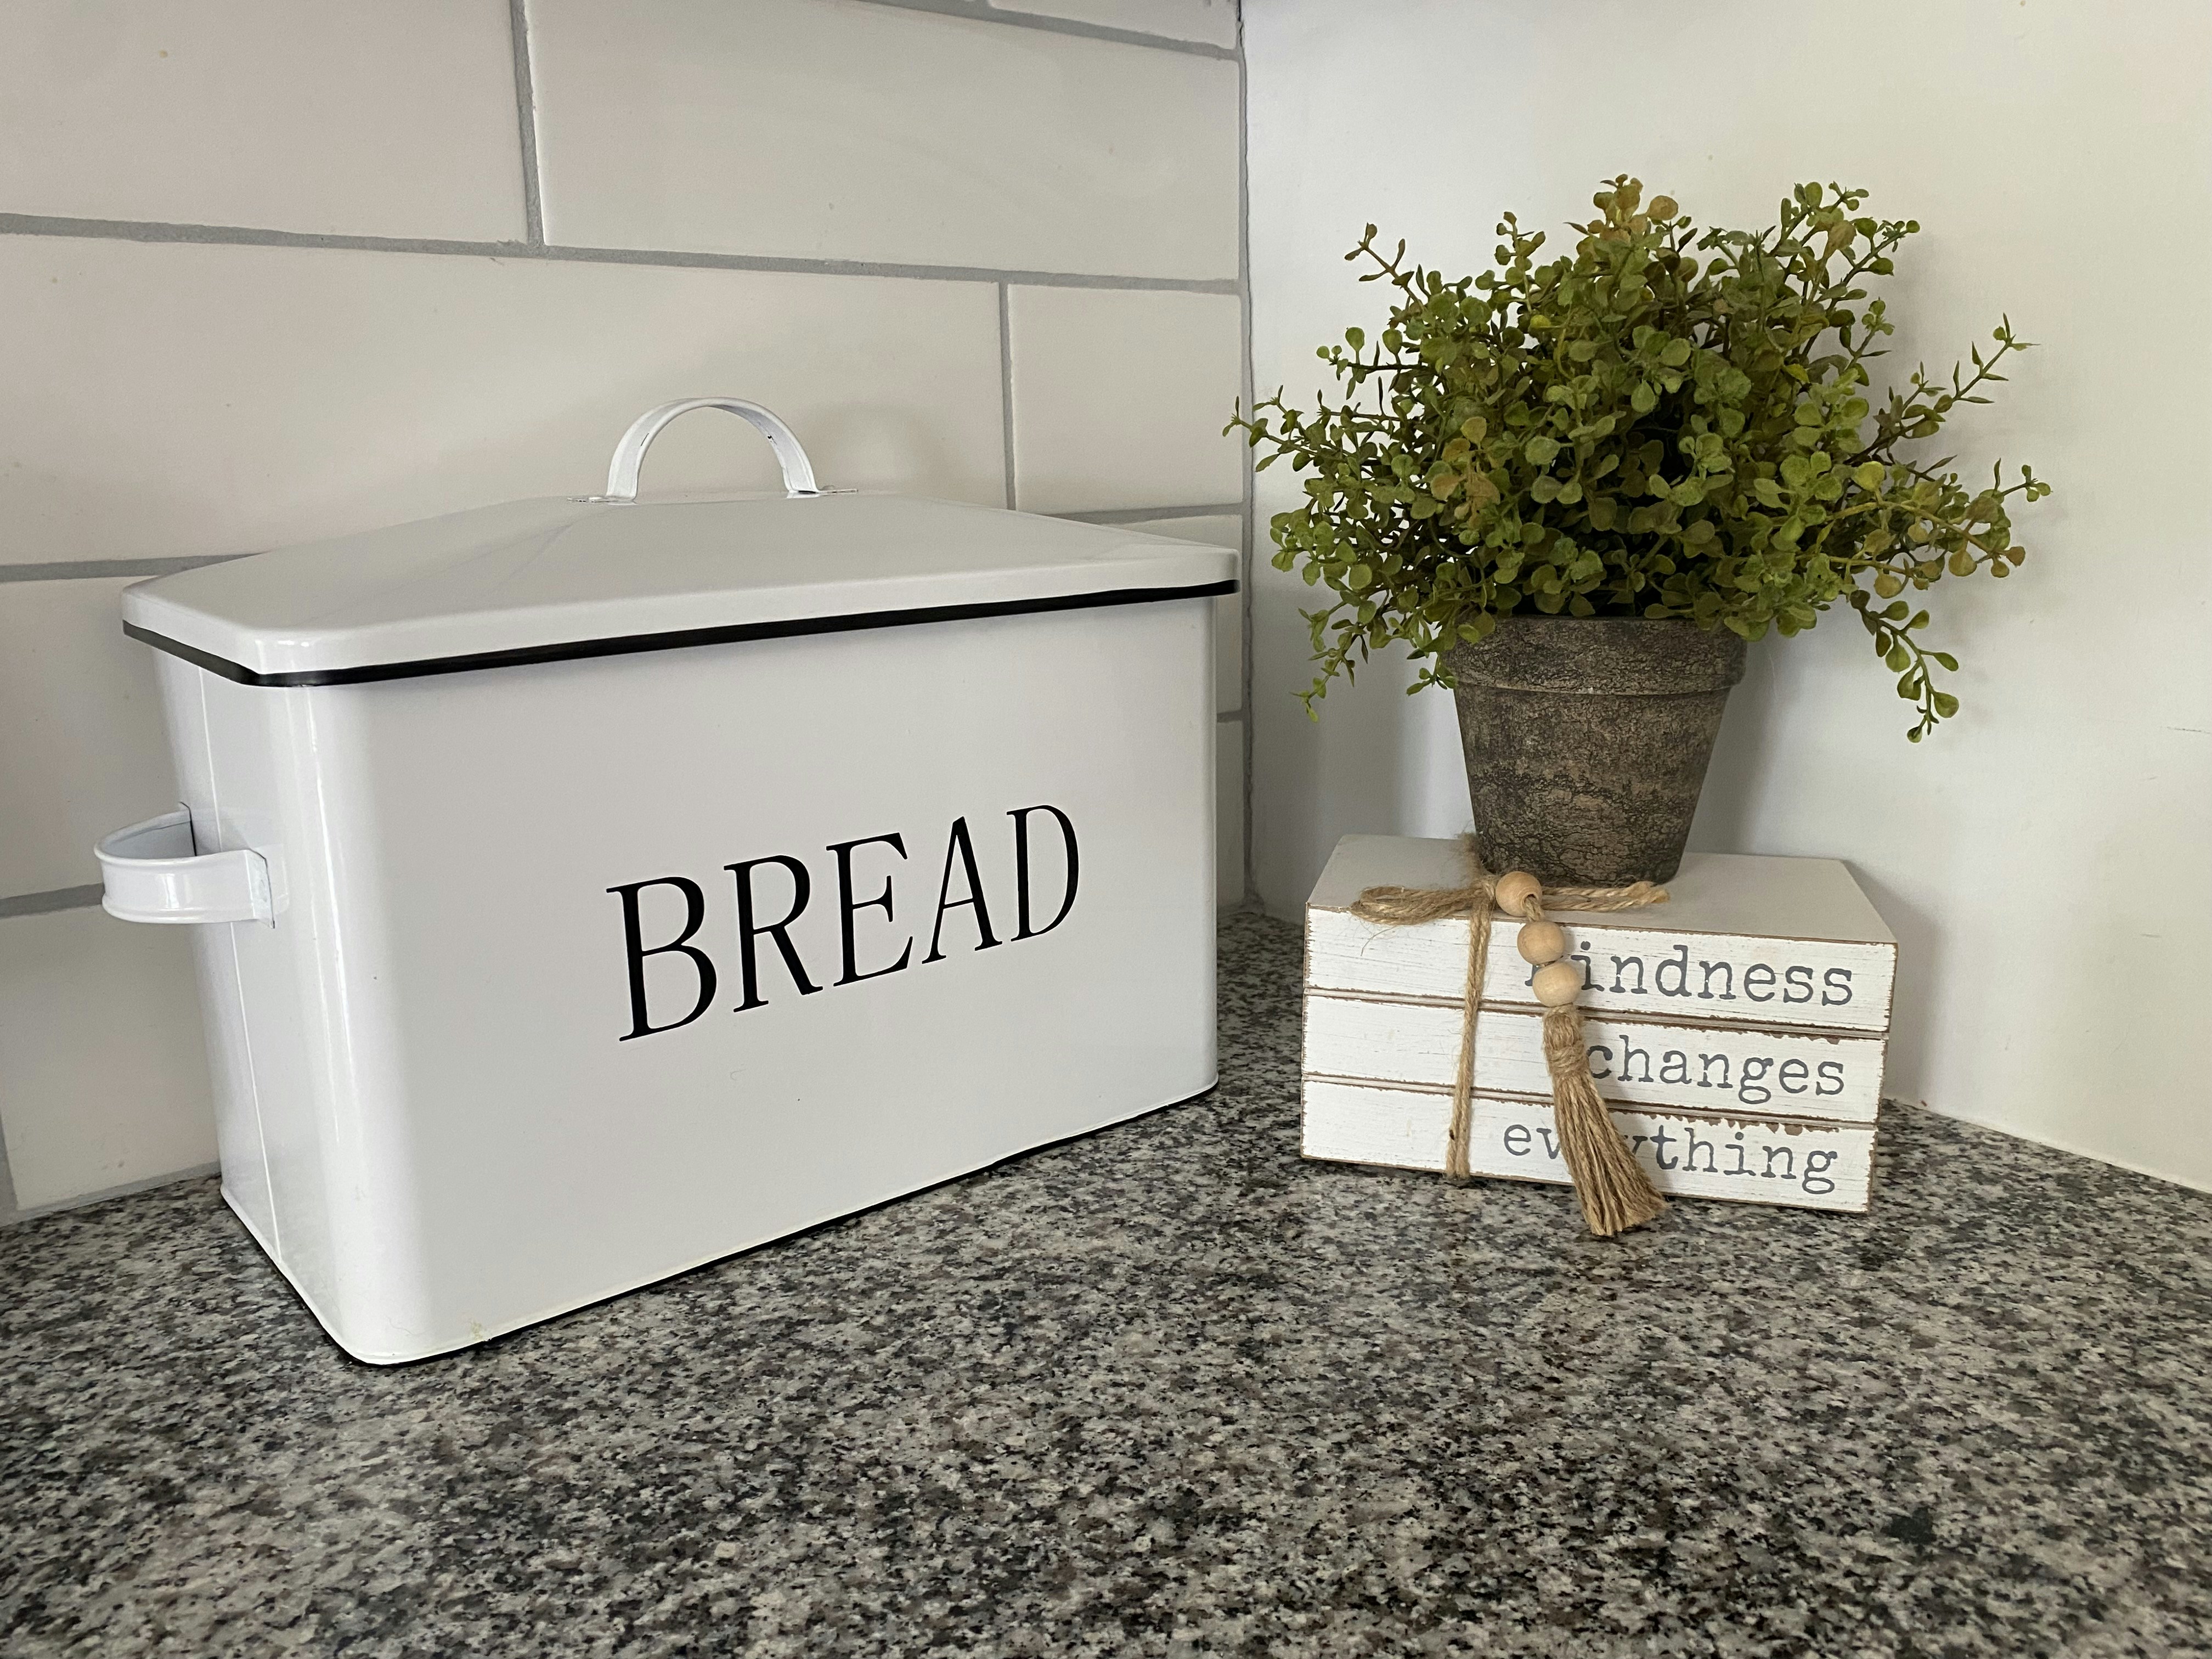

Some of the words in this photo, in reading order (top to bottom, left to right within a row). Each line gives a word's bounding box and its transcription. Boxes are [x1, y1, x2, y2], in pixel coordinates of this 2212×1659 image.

[606, 804, 1080, 1042] BREAD
[1524, 940, 1853, 1007] indness
[1586, 1034, 1844, 1105] changes
[1503, 1124, 1838, 1195] evthing
